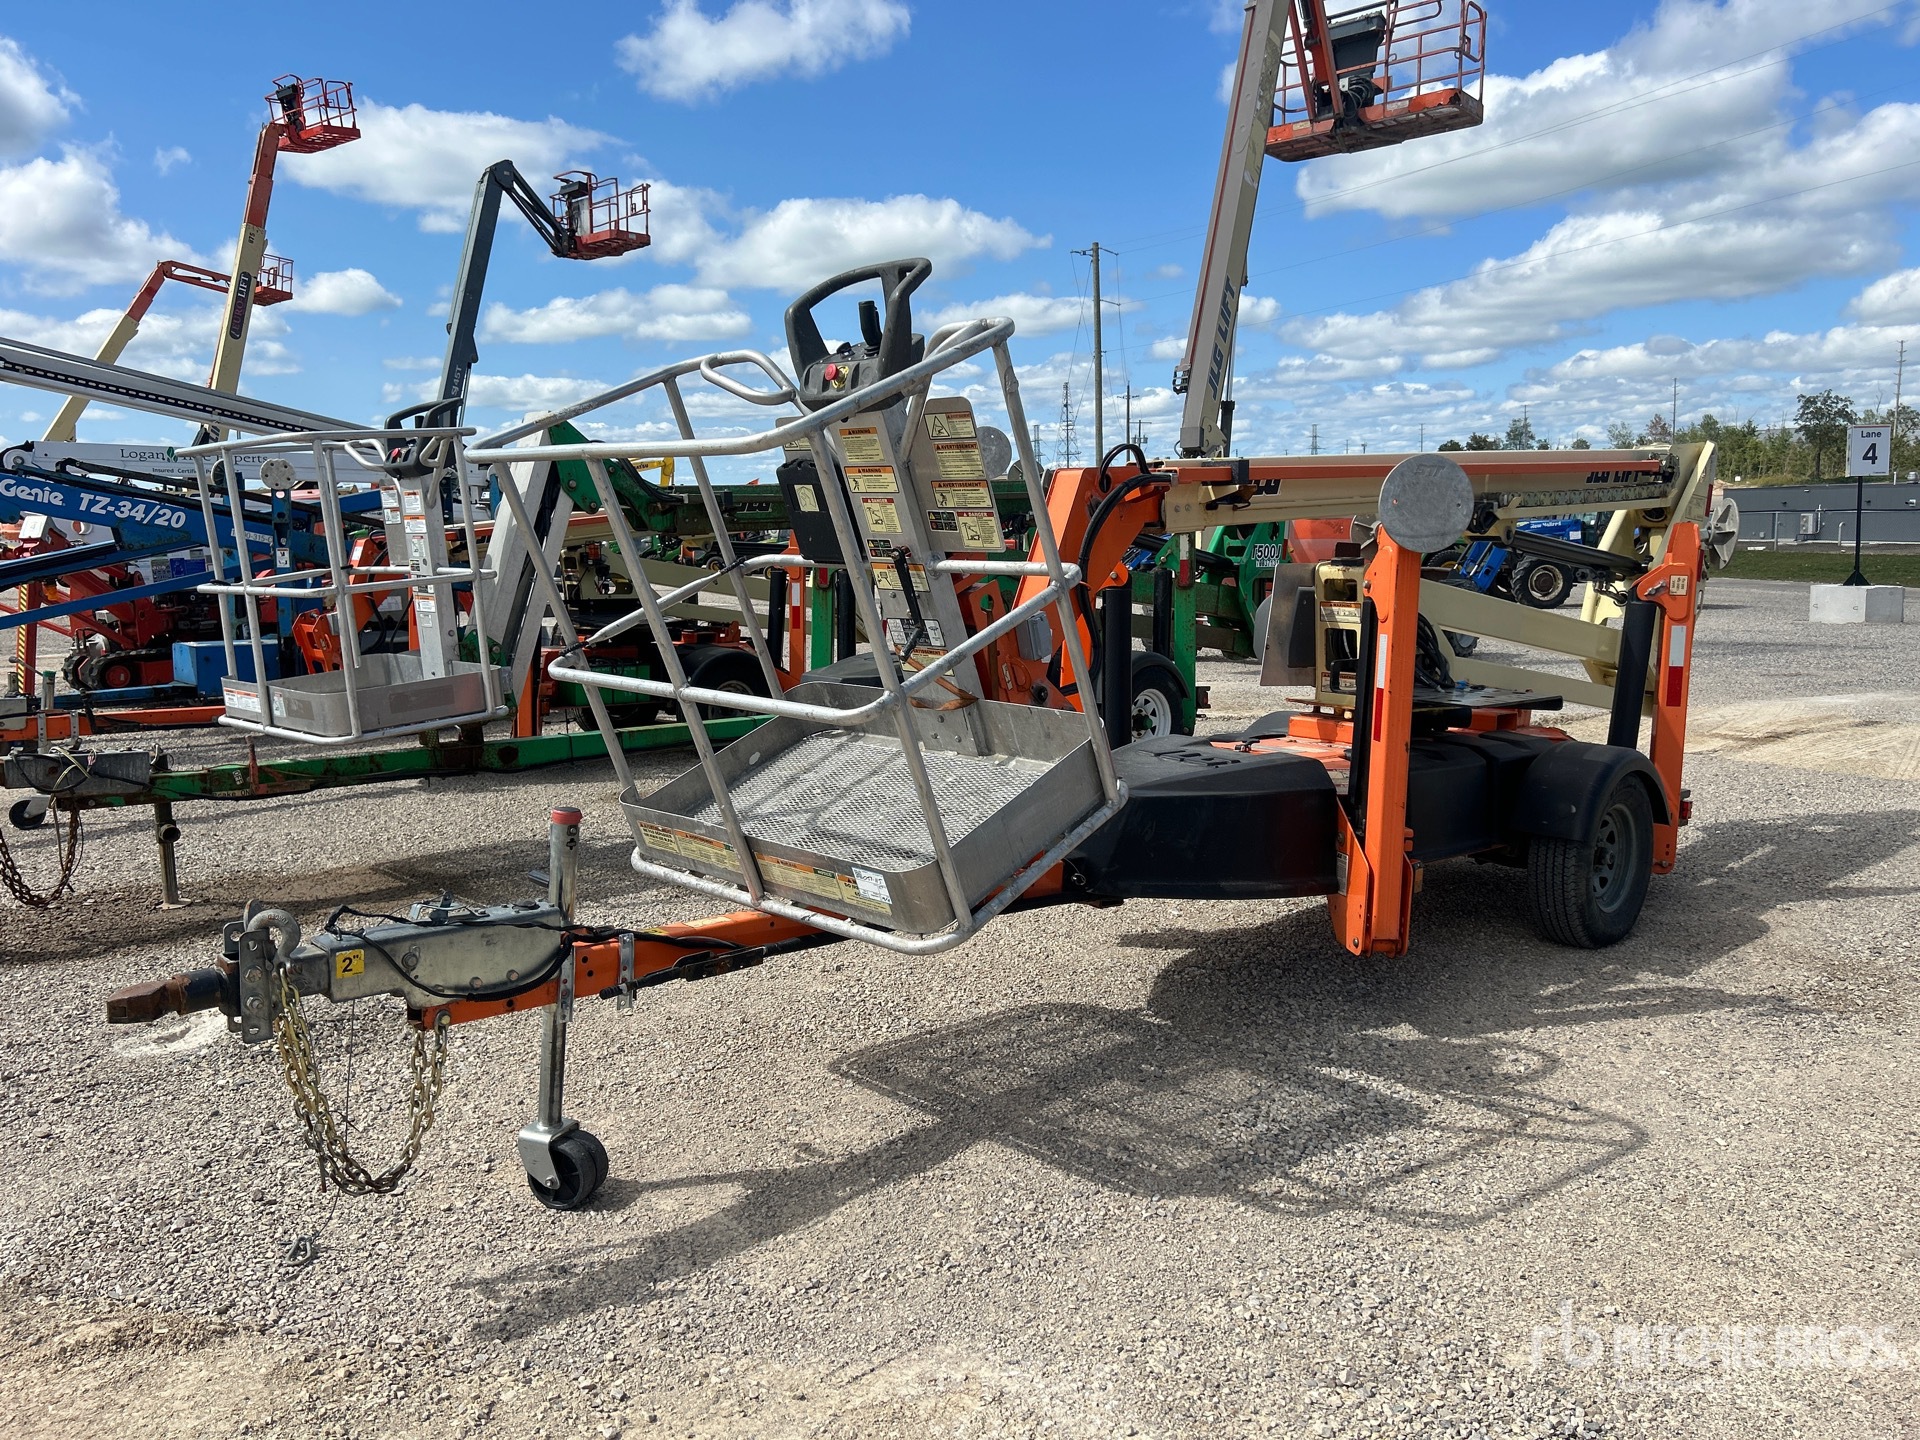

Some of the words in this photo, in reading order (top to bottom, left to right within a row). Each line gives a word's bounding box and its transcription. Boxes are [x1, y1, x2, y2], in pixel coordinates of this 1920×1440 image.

[237, 274, 249, 298] LIFT
[1208, 343, 1224, 400] JLG
[1218, 275, 1236, 343] LIFT
[1860, 430, 1882, 439] Lane
[120, 448, 165, 462] Logan
[1862, 442, 1878, 465] 4
[0, 478, 64, 506] Genie
[79, 492, 187, 529] TZ-34/20
[1251, 544, 1283, 560] T500J
